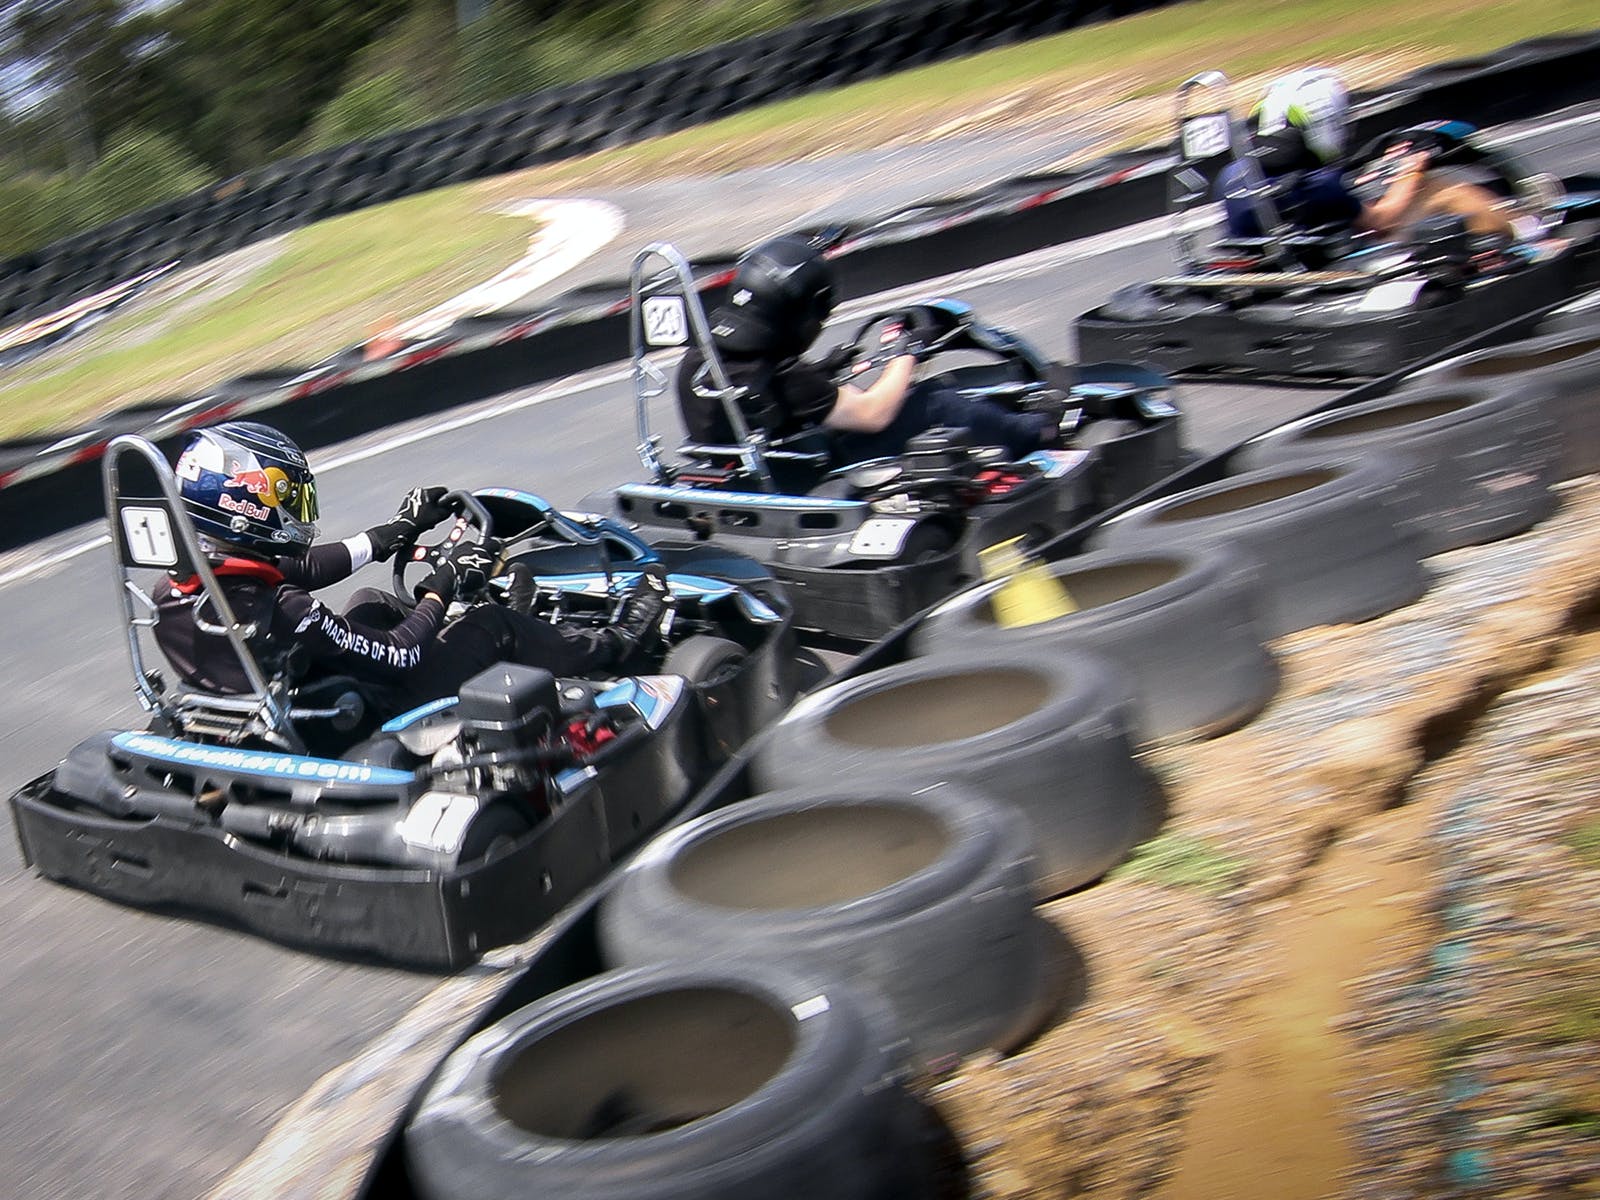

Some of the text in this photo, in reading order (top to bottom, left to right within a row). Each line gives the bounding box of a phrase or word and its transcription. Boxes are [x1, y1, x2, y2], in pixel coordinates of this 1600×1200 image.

[218, 493, 271, 521] Red Bull
[140, 516, 157, 556] 1
[371, 641, 386, 661] OF
